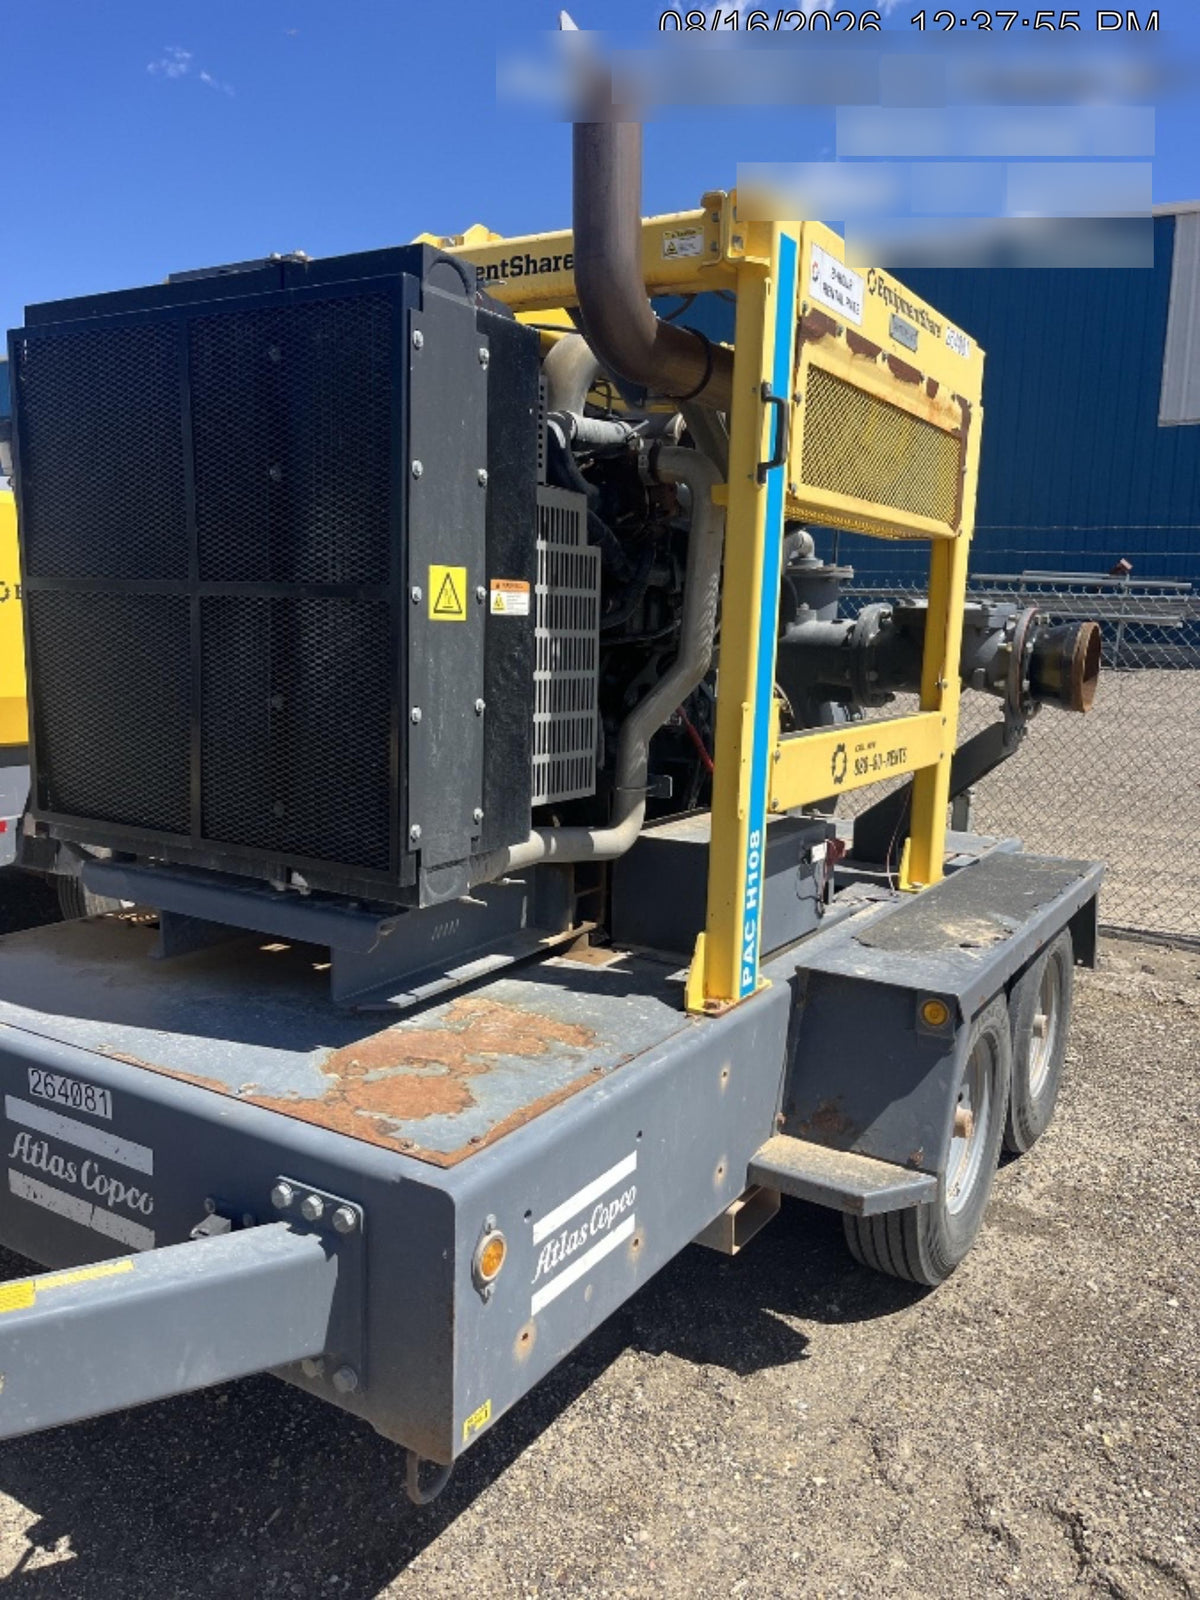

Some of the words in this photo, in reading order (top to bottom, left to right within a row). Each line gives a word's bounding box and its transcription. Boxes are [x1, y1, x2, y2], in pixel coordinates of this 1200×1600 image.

[746, 829, 760, 909] H108
[742, 919, 756, 987] PAC
[31, 1069, 109, 1117] 264081
